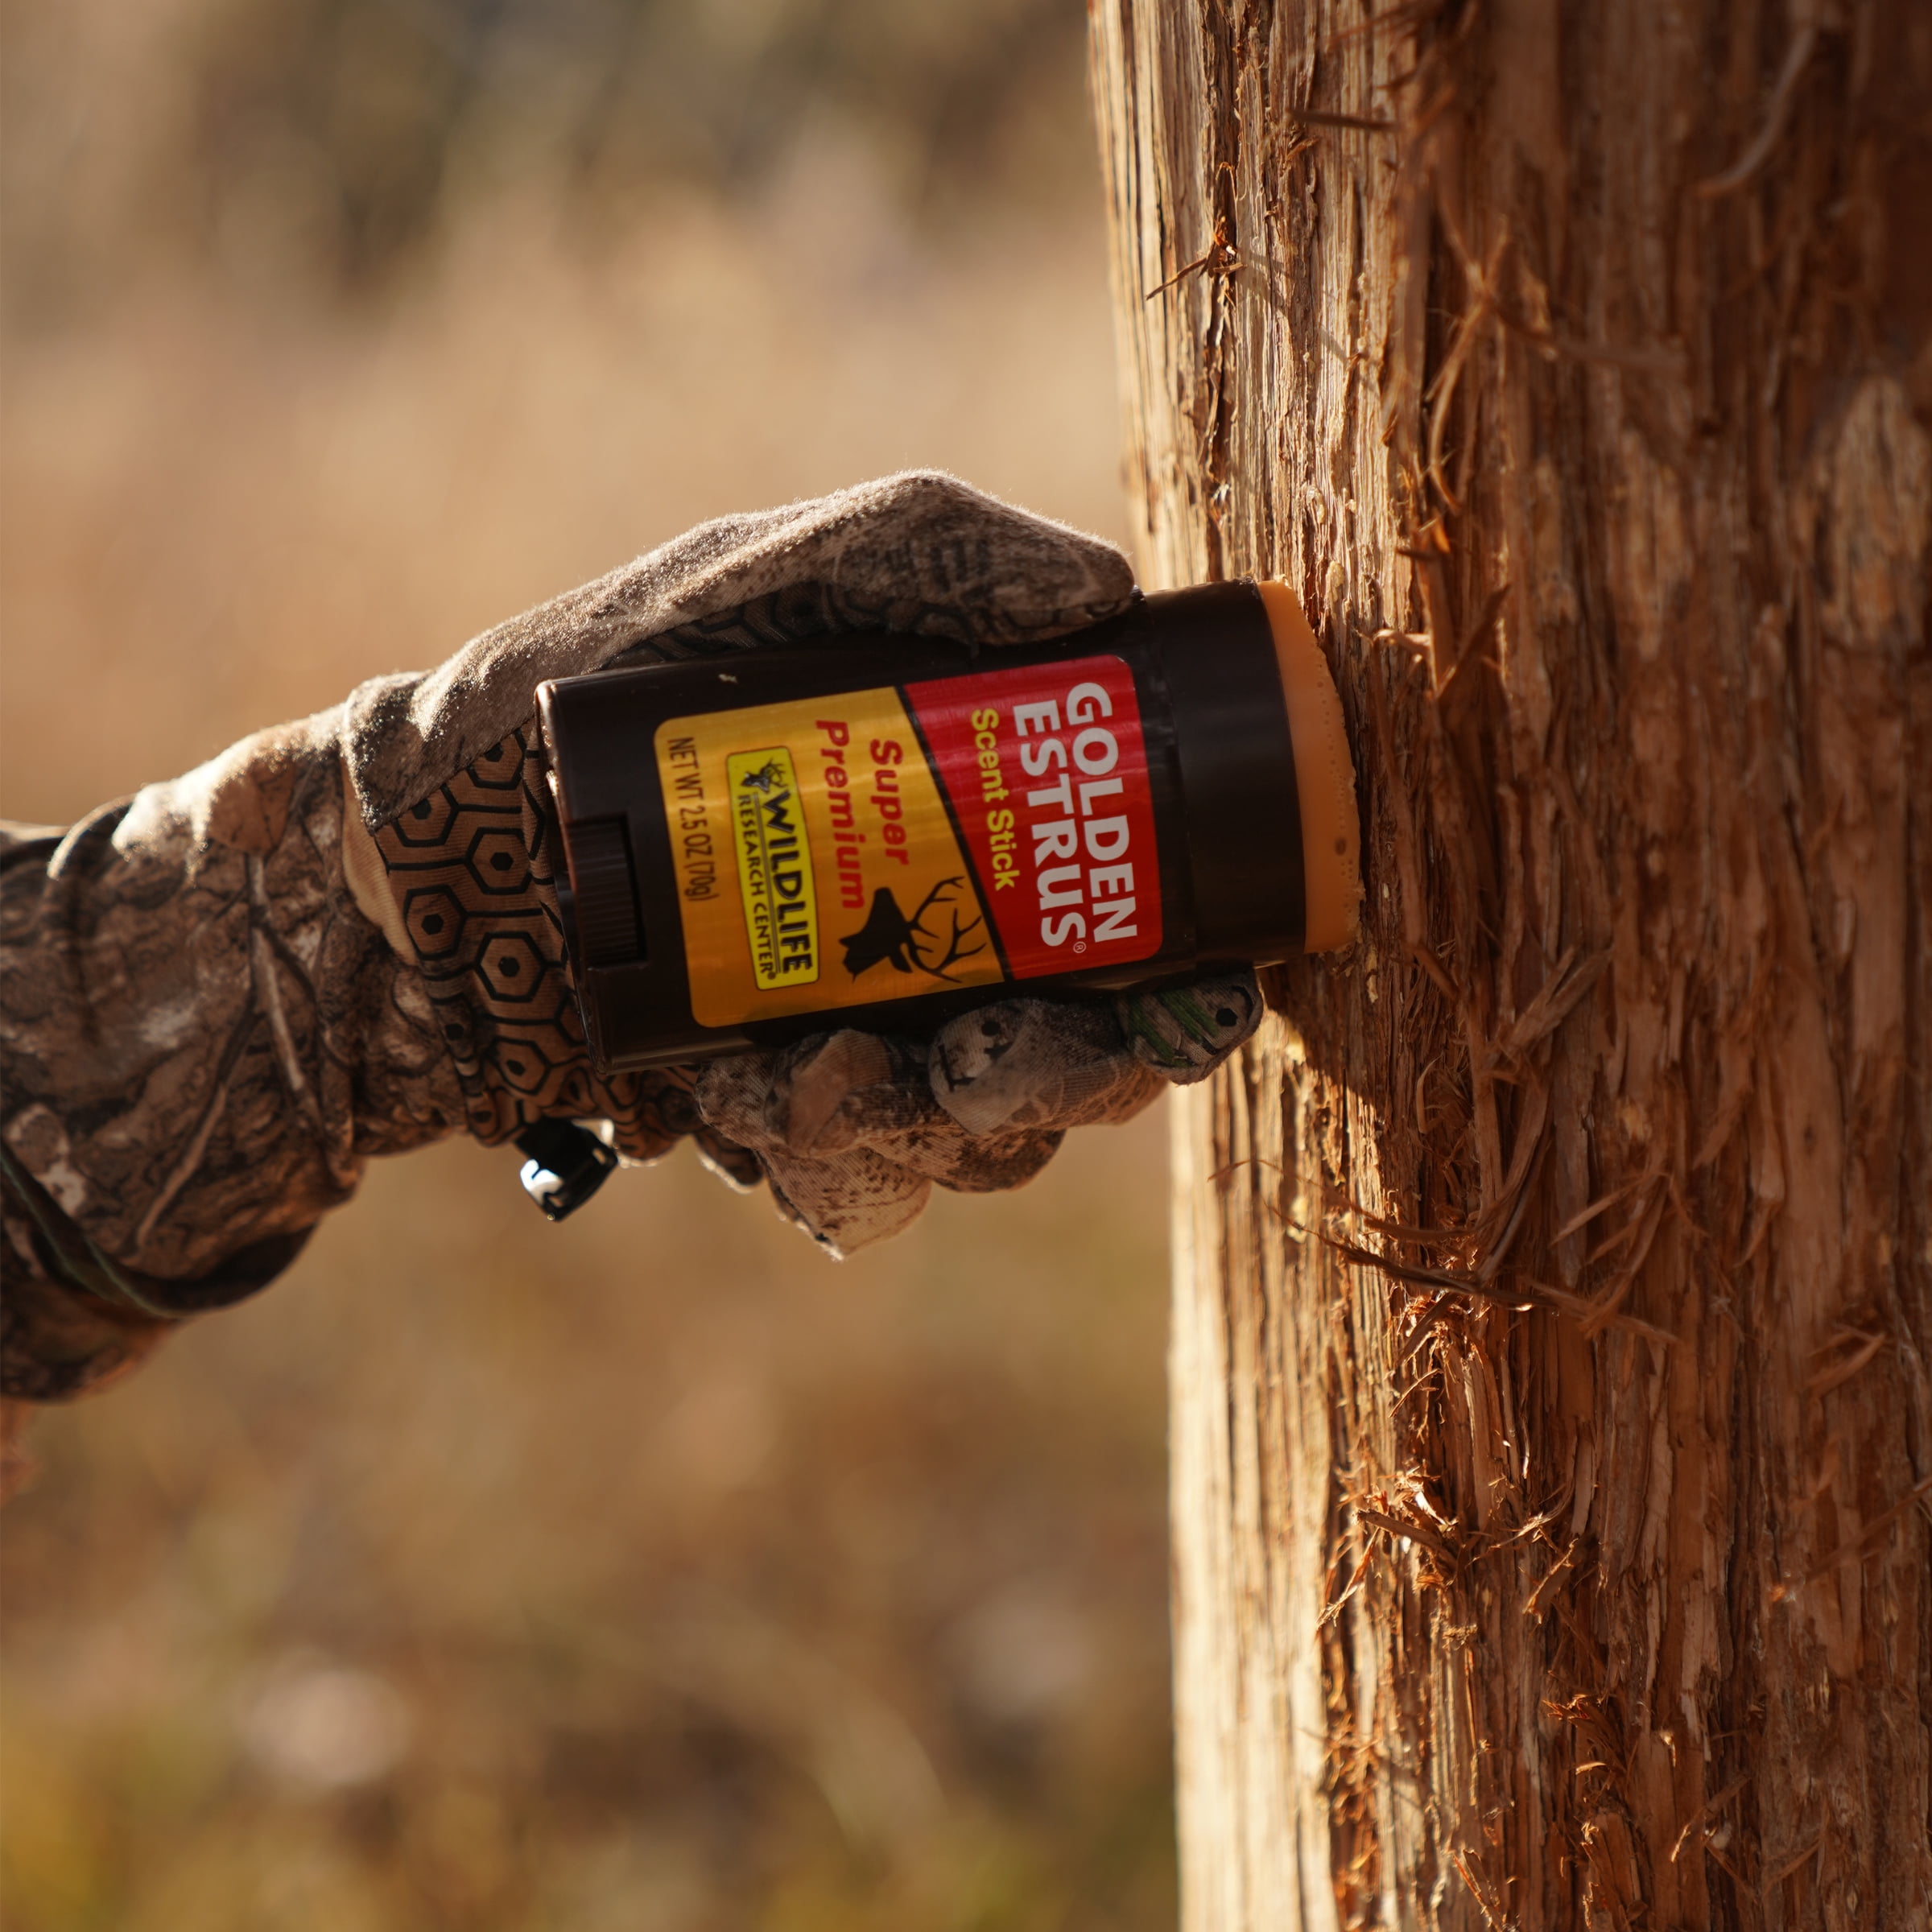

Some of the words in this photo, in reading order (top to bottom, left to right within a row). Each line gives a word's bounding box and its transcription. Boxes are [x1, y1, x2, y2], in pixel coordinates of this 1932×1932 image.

[667, 737, 700, 770] NET
[675, 772, 704, 800] WT
[972, 708, 1009, 803] Scent
[679, 805, 708, 830] 2.5
[683, 833, 712, 858] OZ
[737, 795, 765, 897] RESEARCH
[815, 720, 866, 909] Premium
[869, 738, 909, 866] Super
[1066, 682, 1137, 943] GOLDEN
[683, 861, 720, 902] (70g)
[763, 790, 813, 974] WILDLIFE
[987, 809, 1020, 891] Stick
